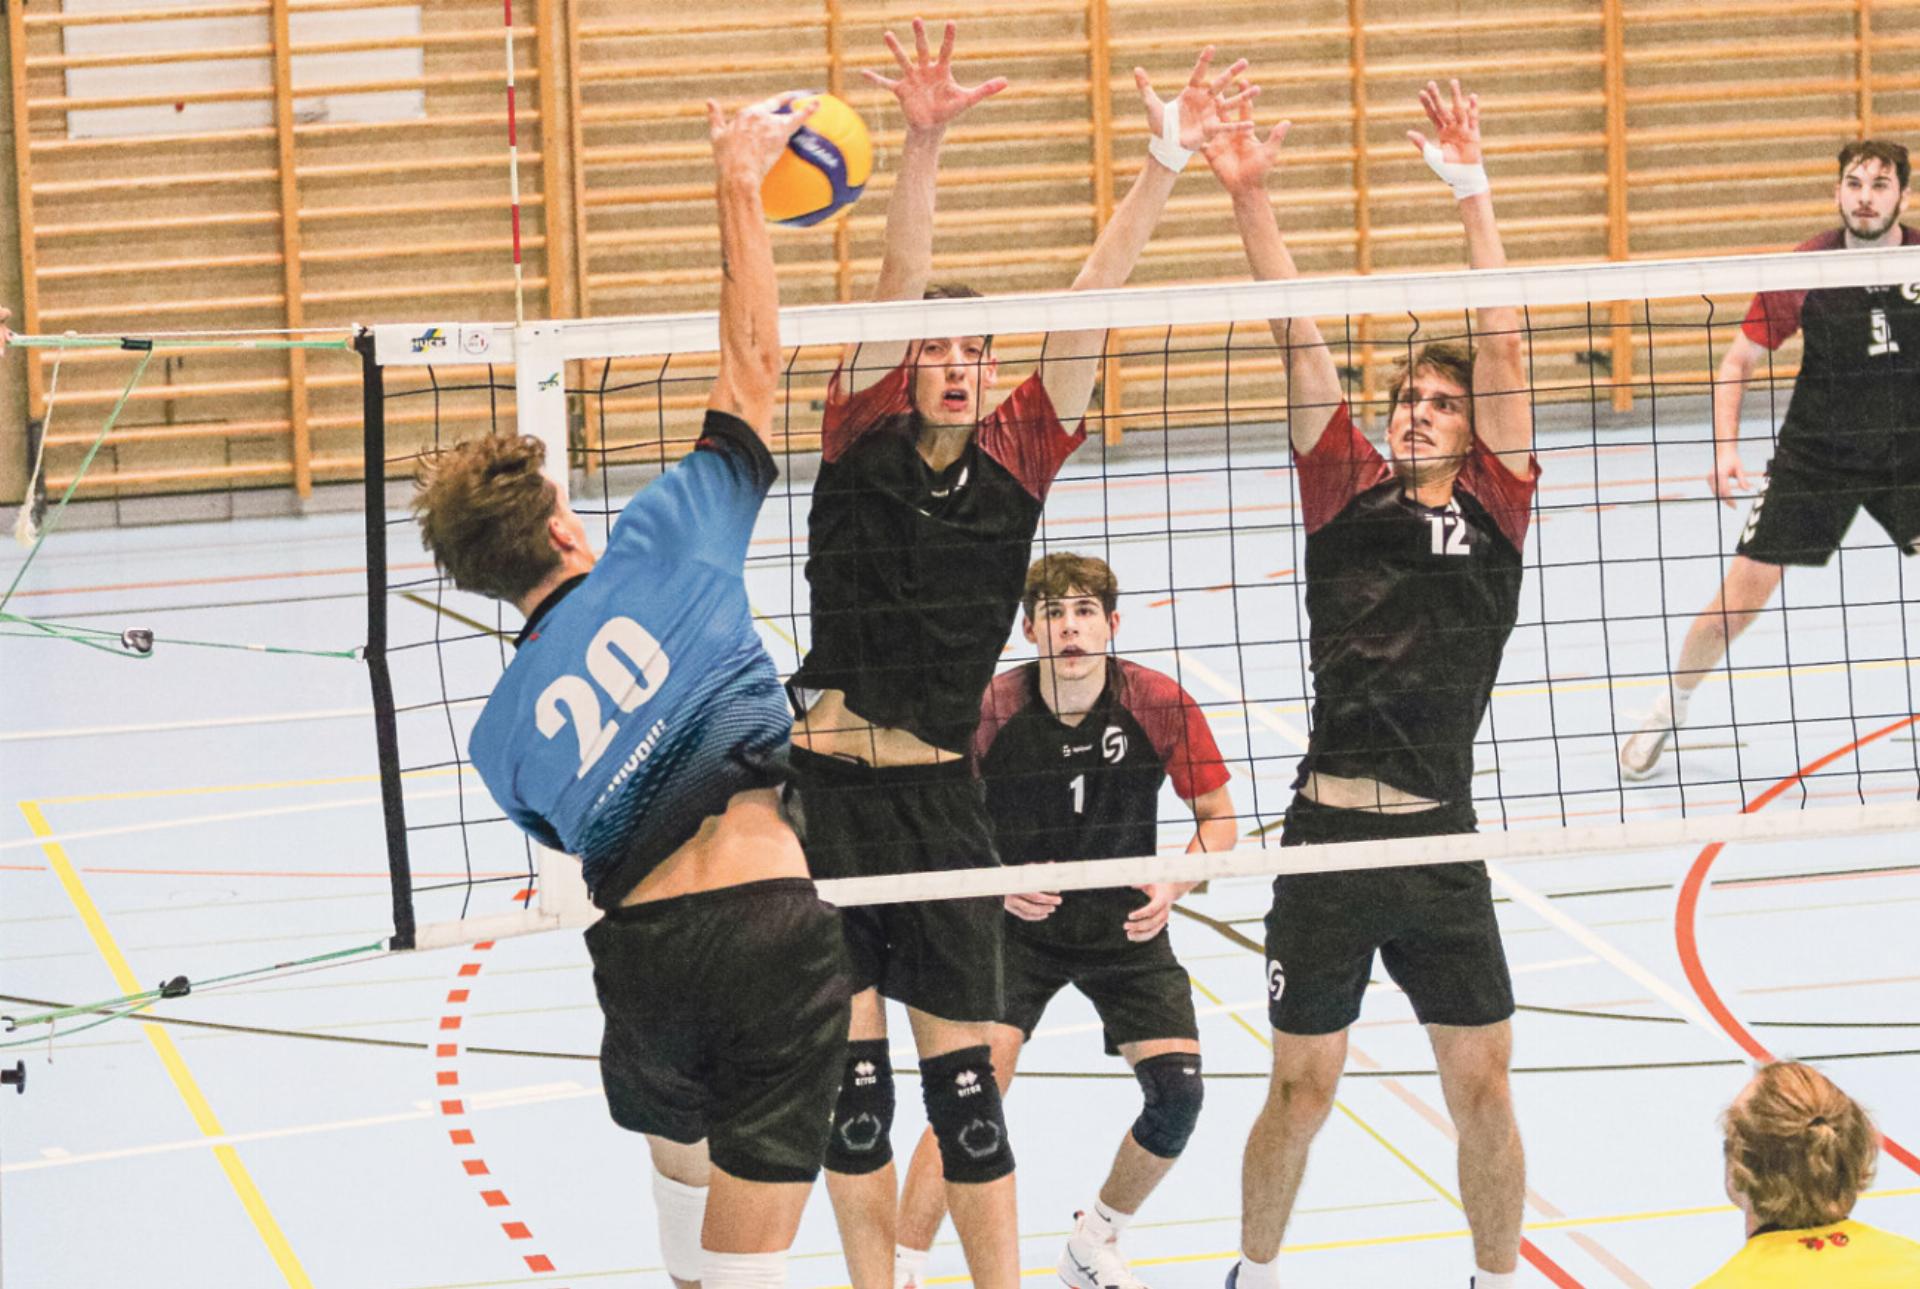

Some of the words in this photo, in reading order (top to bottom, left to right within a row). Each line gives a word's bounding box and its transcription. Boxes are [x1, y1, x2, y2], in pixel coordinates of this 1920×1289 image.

[1871, 309, 1892, 345] 5
[1424, 513, 1470, 555] 12
[535, 616, 670, 780] 20
[1070, 774, 1084, 814] 1
